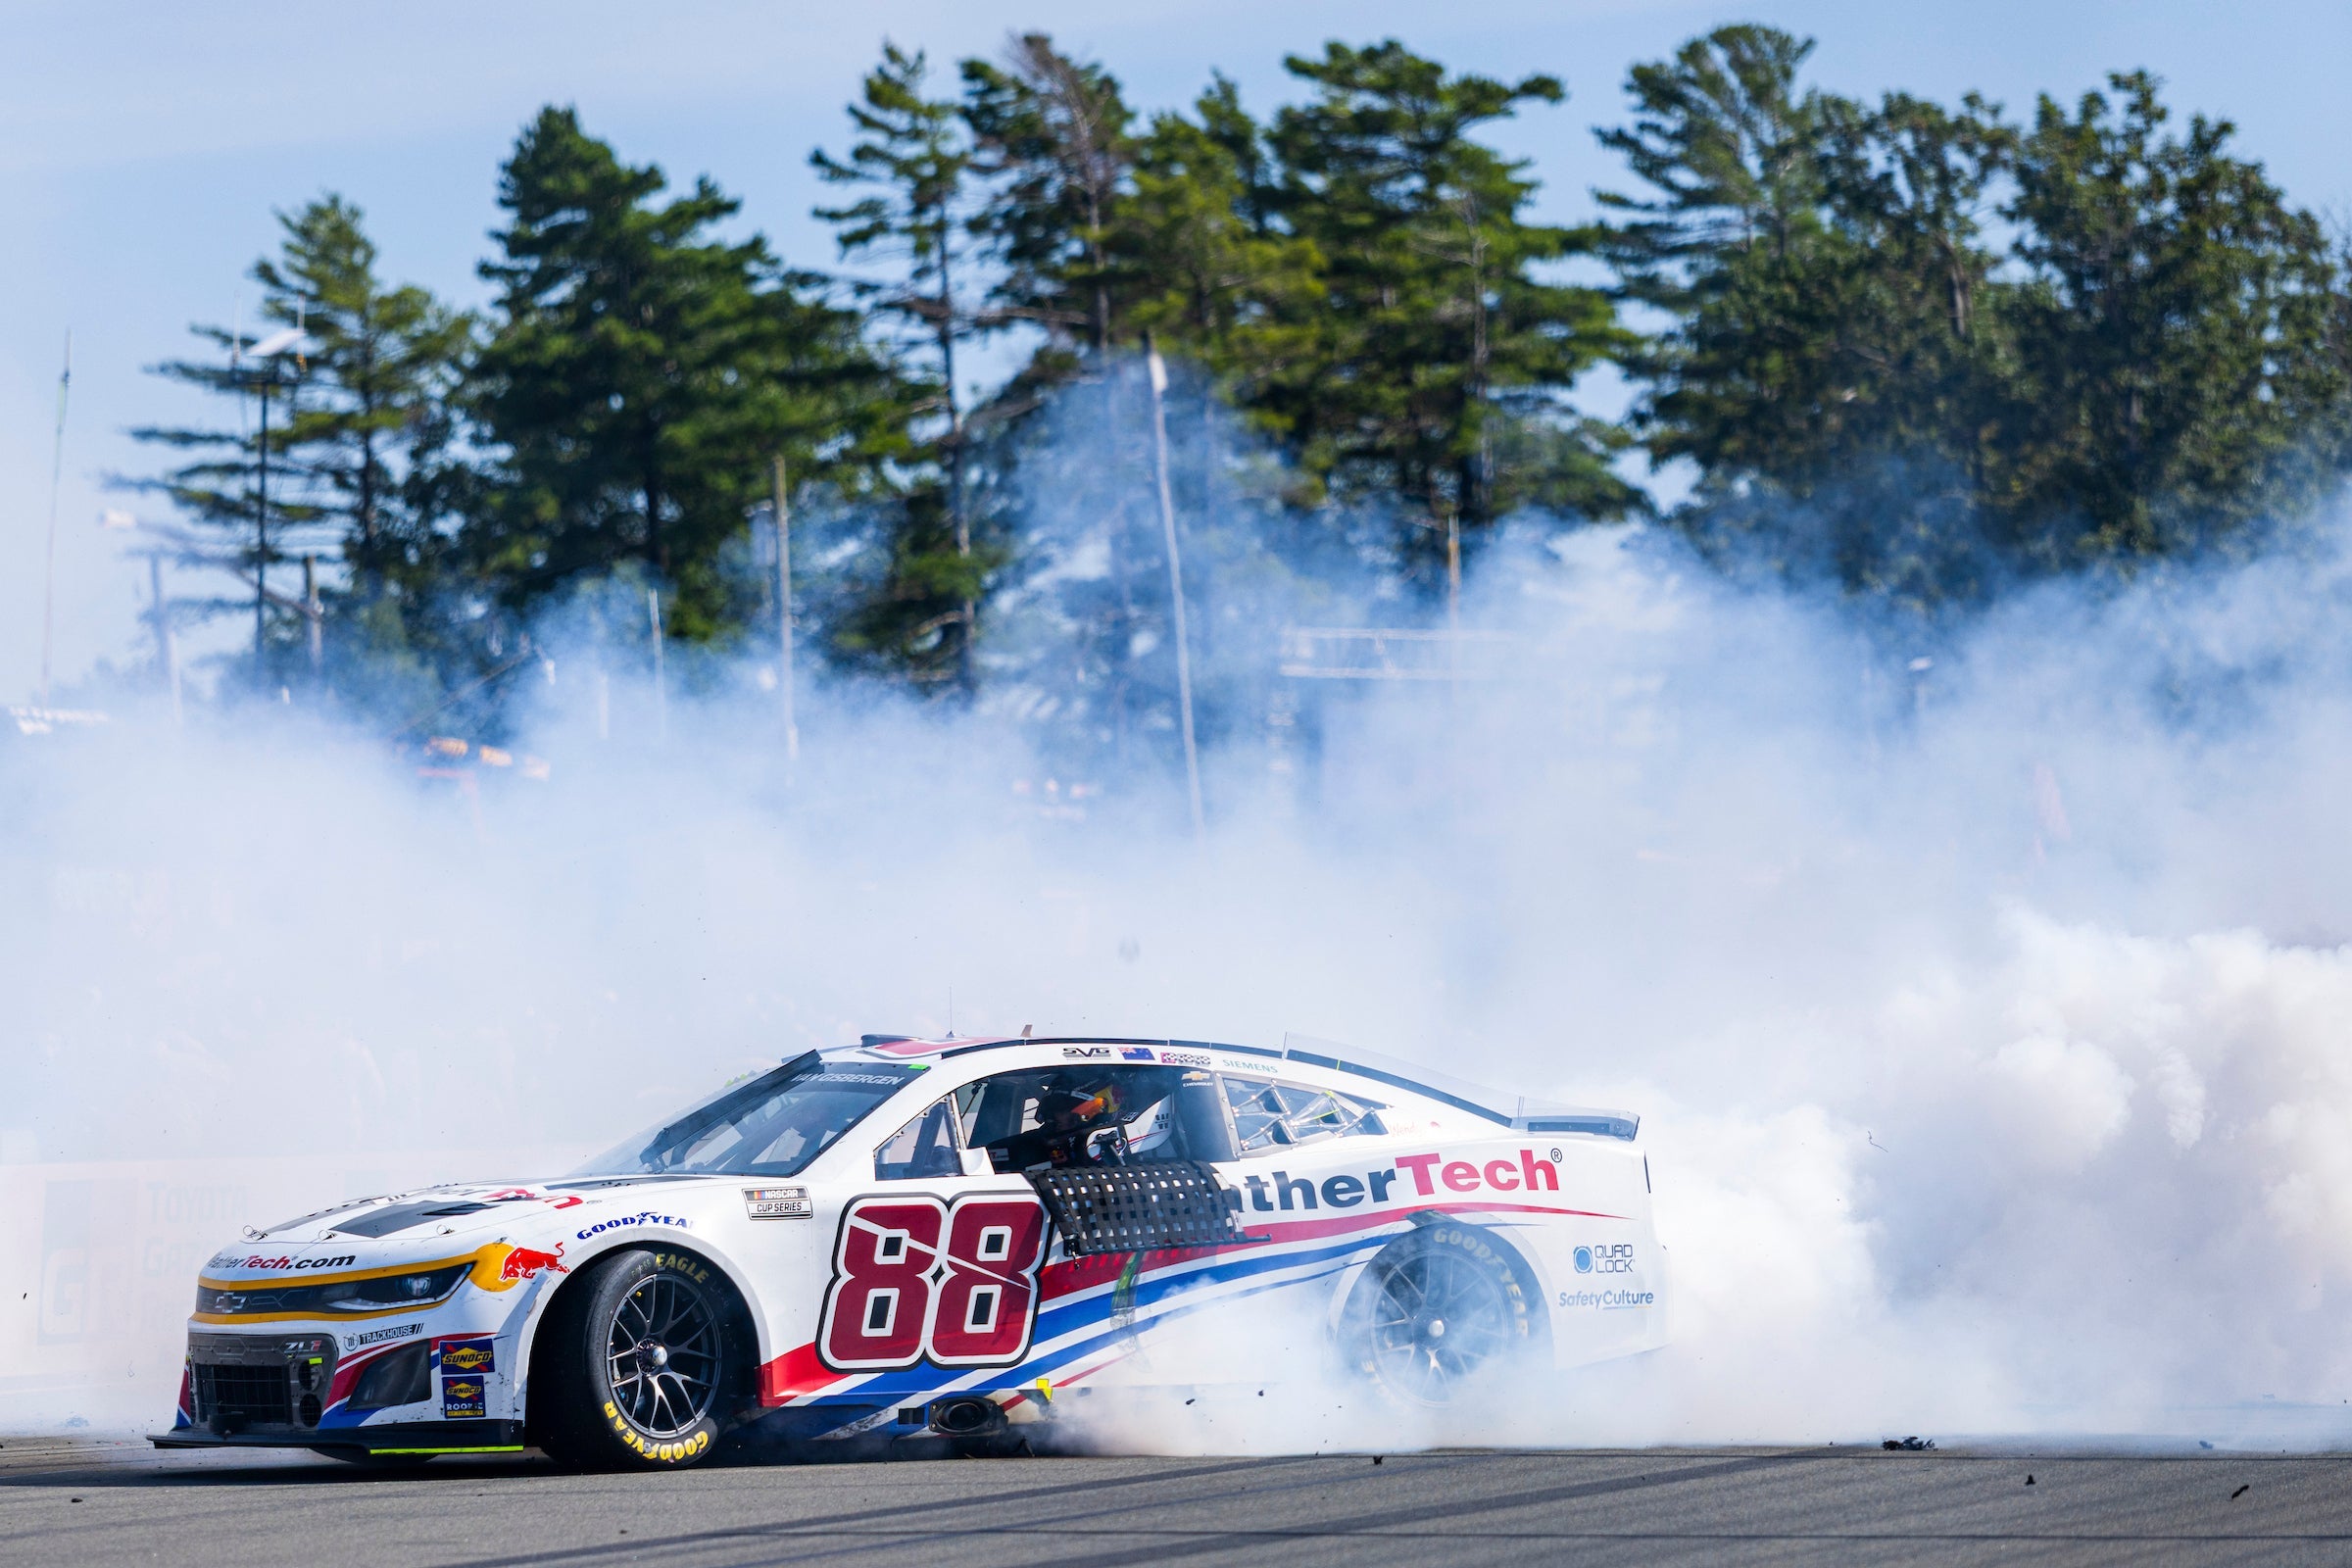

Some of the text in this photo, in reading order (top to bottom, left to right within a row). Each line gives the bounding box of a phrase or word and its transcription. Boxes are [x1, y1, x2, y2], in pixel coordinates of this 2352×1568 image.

[1062, 1048, 1110, 1056] SVG
[1223, 1058, 1278, 1073] SIEMENS
[821, 1074, 905, 1086] GISBERGEN
[764, 1189, 799, 1200] NASCAR
[757, 1201, 803, 1212] CUP SERIES
[1594, 1244, 1633, 1258] QUAD
[656, 1252, 710, 1284] EAGLE
[1595, 1259, 1634, 1273] LOCK
[821, 1193, 1049, 1370] 88
[1558, 1290, 1654, 1310] SafetyCulture
[361, 1325, 413, 1344] TRACKHOUSE
[284, 1340, 321, 1354] ZL1
[444, 1352, 490, 1363] SUNOCO
[448, 1386, 481, 1395] SUNOCO
[604, 1399, 710, 1461] GOODYEAR
